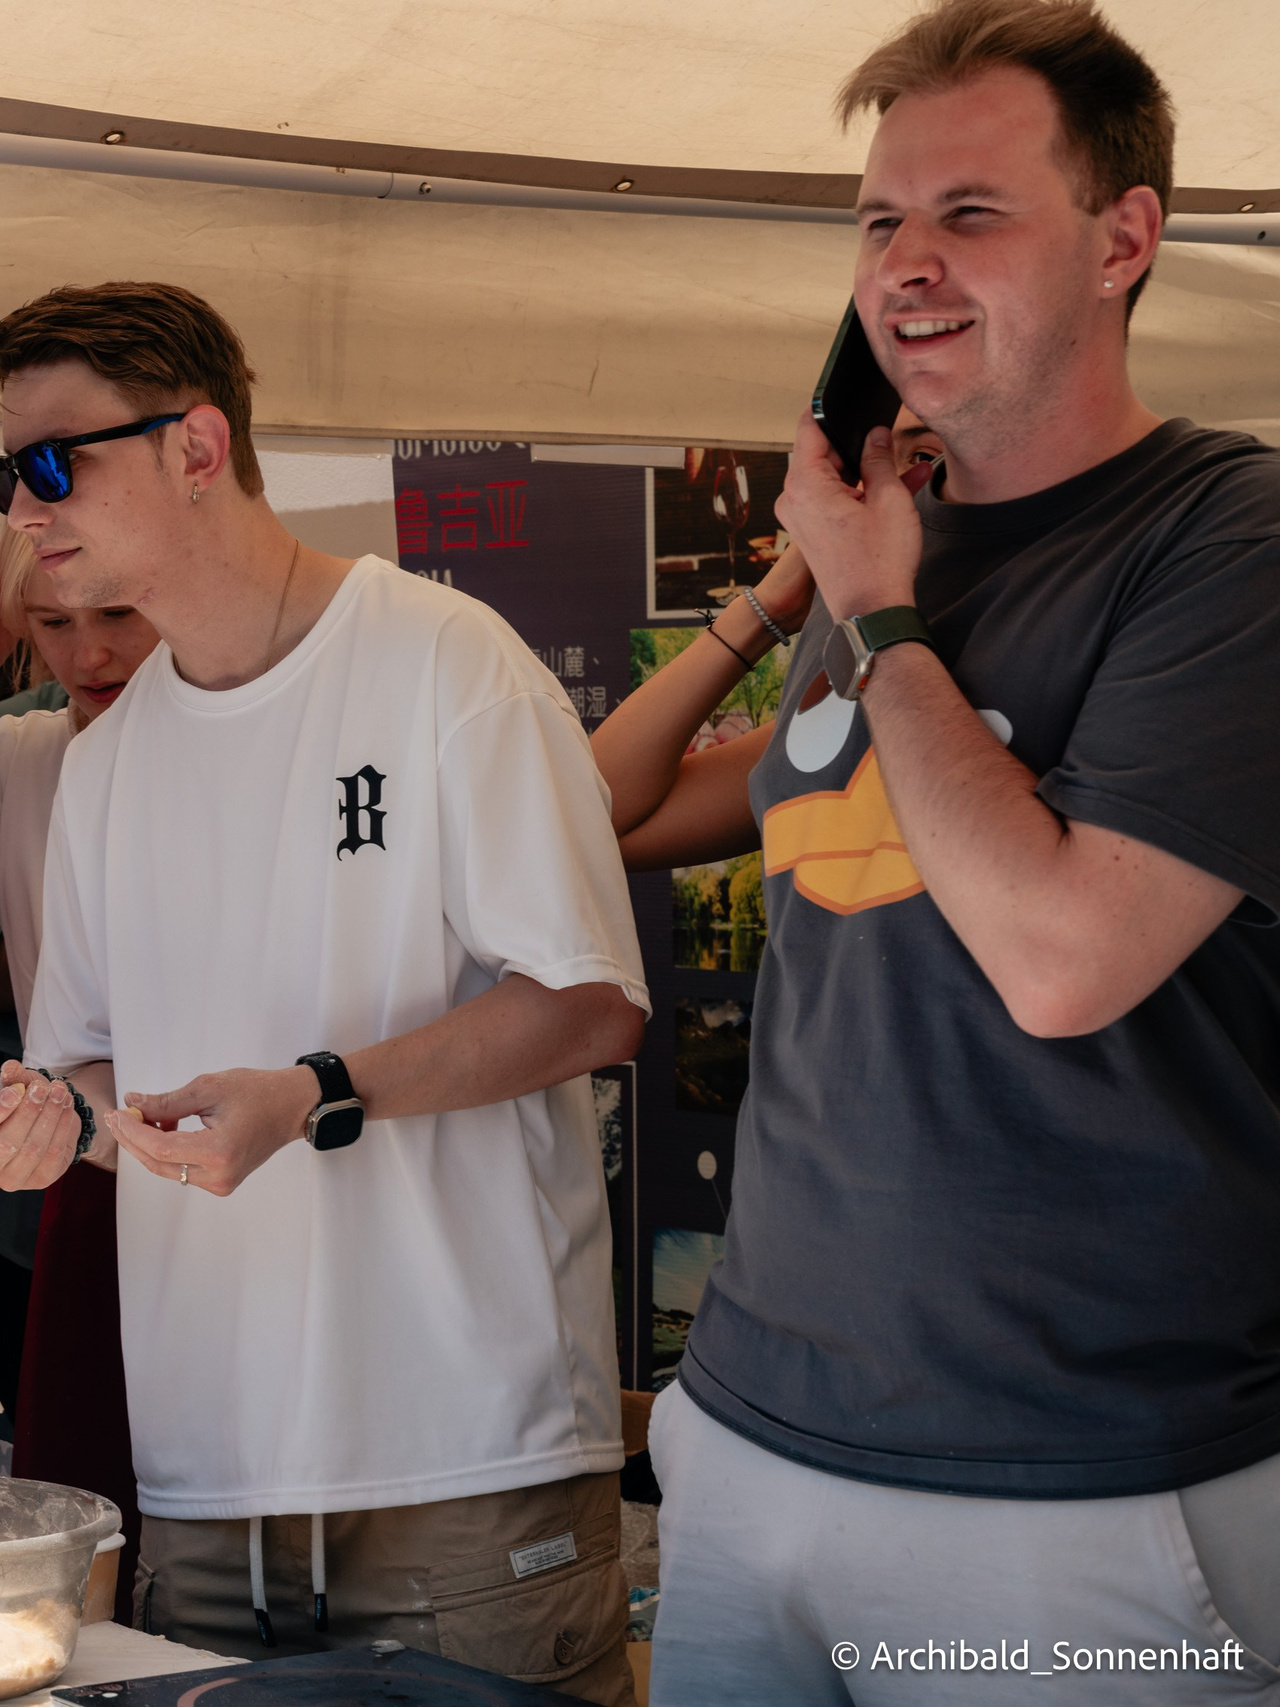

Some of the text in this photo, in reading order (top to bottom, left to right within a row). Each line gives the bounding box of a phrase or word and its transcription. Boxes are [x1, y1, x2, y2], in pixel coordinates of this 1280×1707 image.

[395, 479, 529, 556] 鲁吉亚
[335, 764, 388, 862] B
